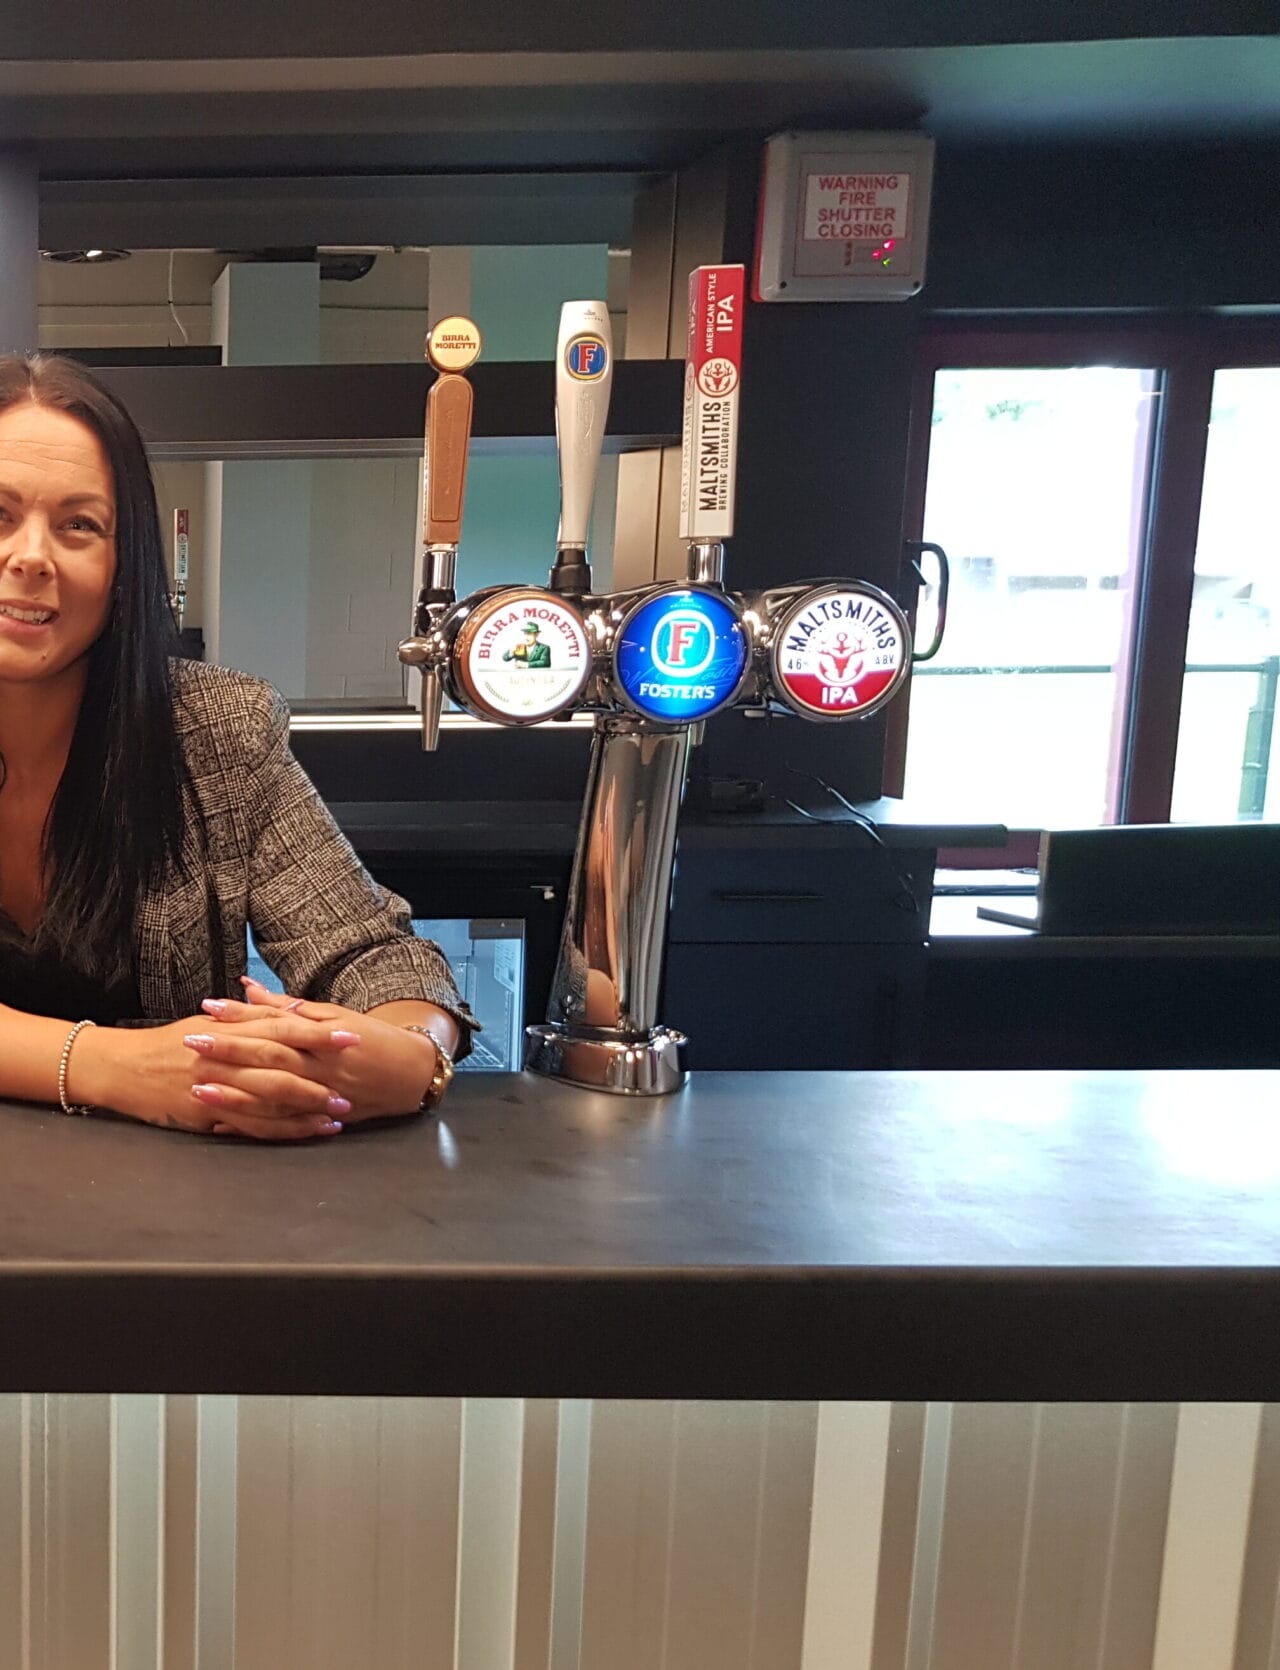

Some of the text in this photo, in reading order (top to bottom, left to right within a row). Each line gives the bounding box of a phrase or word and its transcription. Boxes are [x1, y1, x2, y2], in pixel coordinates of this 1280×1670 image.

[819, 176, 899, 190] WARNING
[839, 192, 876, 205] FIRE
[818, 208, 896, 221] SHUTTER
[818, 223, 893, 237] CLOSING
[705, 273, 717, 354] AMERICAN STYLE
[716, 294, 734, 332] IPA
[577, 343, 597, 373] F
[699, 402, 721, 511] MALTSMITHS
[718, 401, 731, 511] BREWING COLLABORATION
[478, 607, 580, 659] BIRRA MORETTI
[666, 621, 700, 664] F
[786, 600, 896, 652] MALTSMITHS
[639, 682, 716, 699] FOSTER'S
[822, 686, 858, 704] IPA
